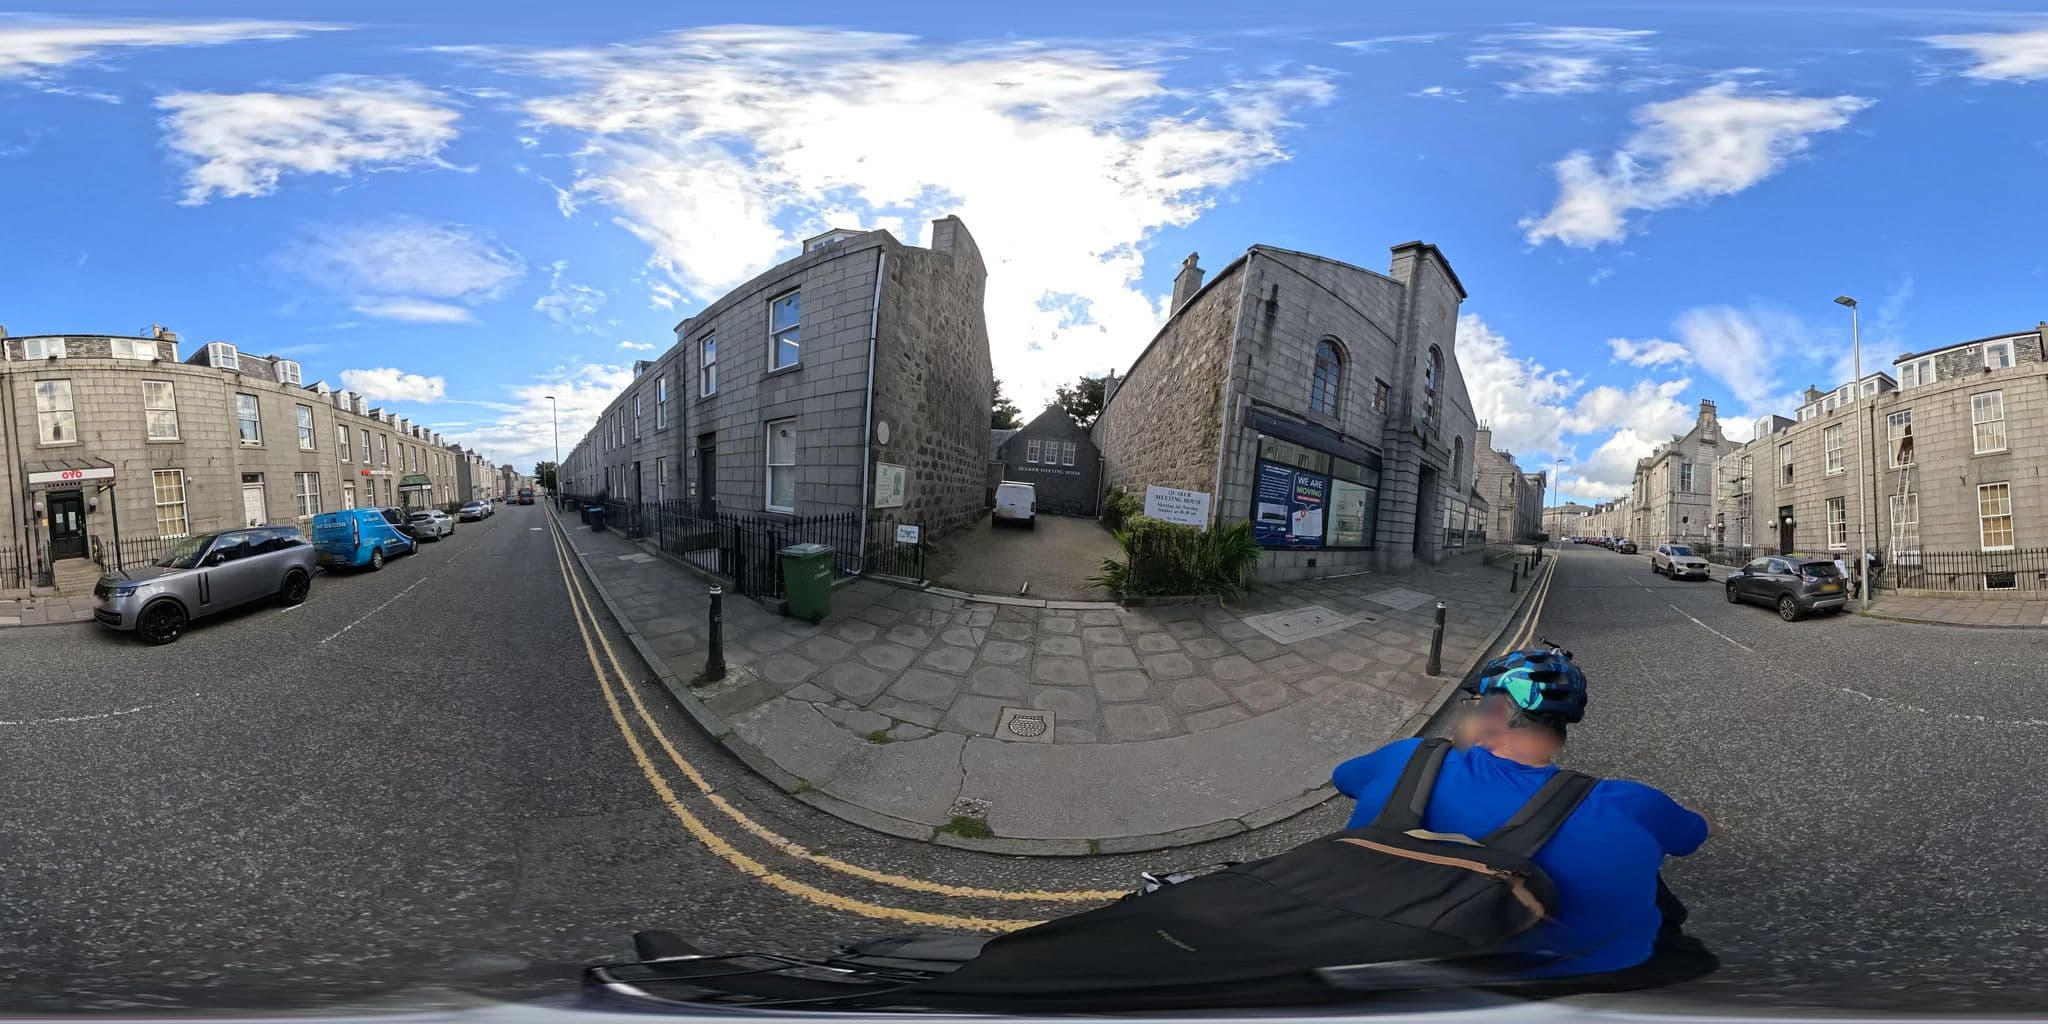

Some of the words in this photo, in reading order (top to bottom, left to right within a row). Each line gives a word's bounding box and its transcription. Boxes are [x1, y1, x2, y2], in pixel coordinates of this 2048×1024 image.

[61, 470, 83, 479] OYO
[1297, 475, 1309, 486] WE
[1310, 479, 1323, 489] ARE
[1296, 486, 1322, 497] MOVING
